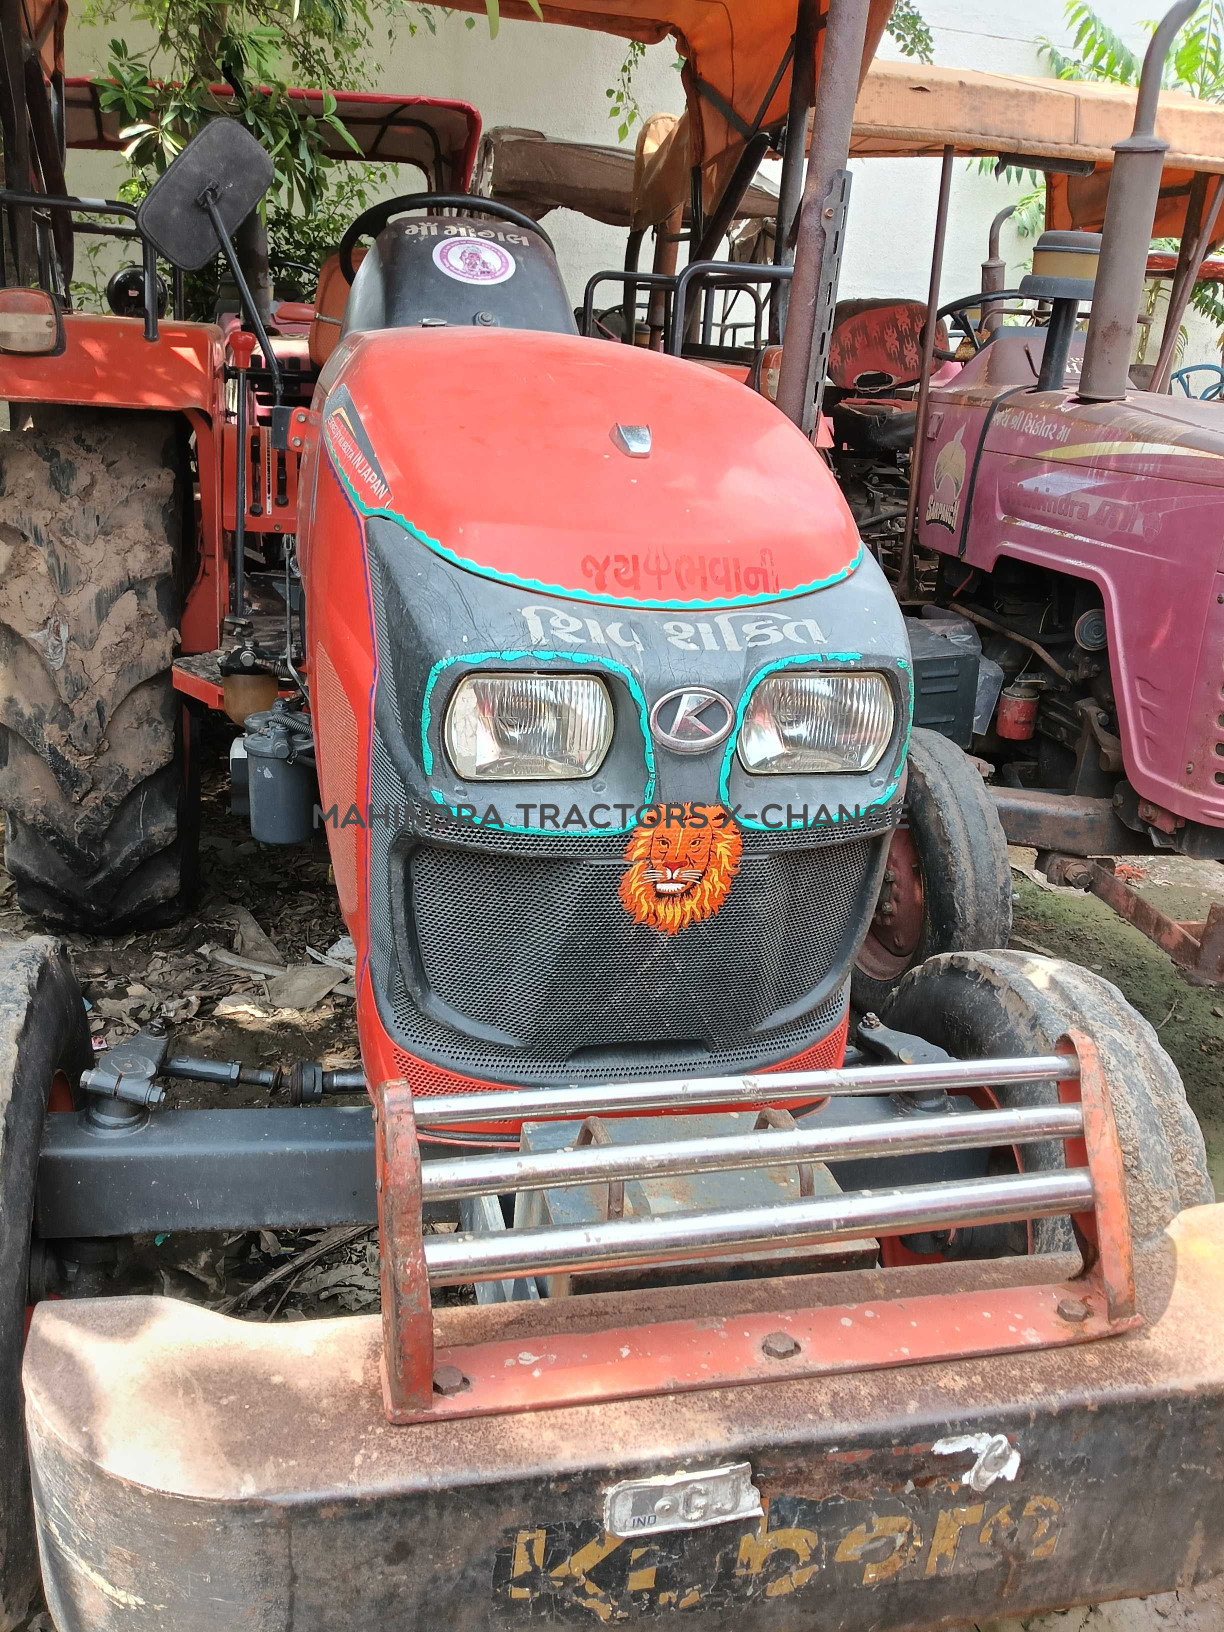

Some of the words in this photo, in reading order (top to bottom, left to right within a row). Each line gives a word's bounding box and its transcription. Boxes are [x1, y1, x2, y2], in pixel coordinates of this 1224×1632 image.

[351, 452, 363, 468] IN
[357, 463, 389, 500] JAPAN
[580, 554, 640, 591] જય
[520, 605, 645, 653] શિવ
[631, 1514, 657, 1528] IND
